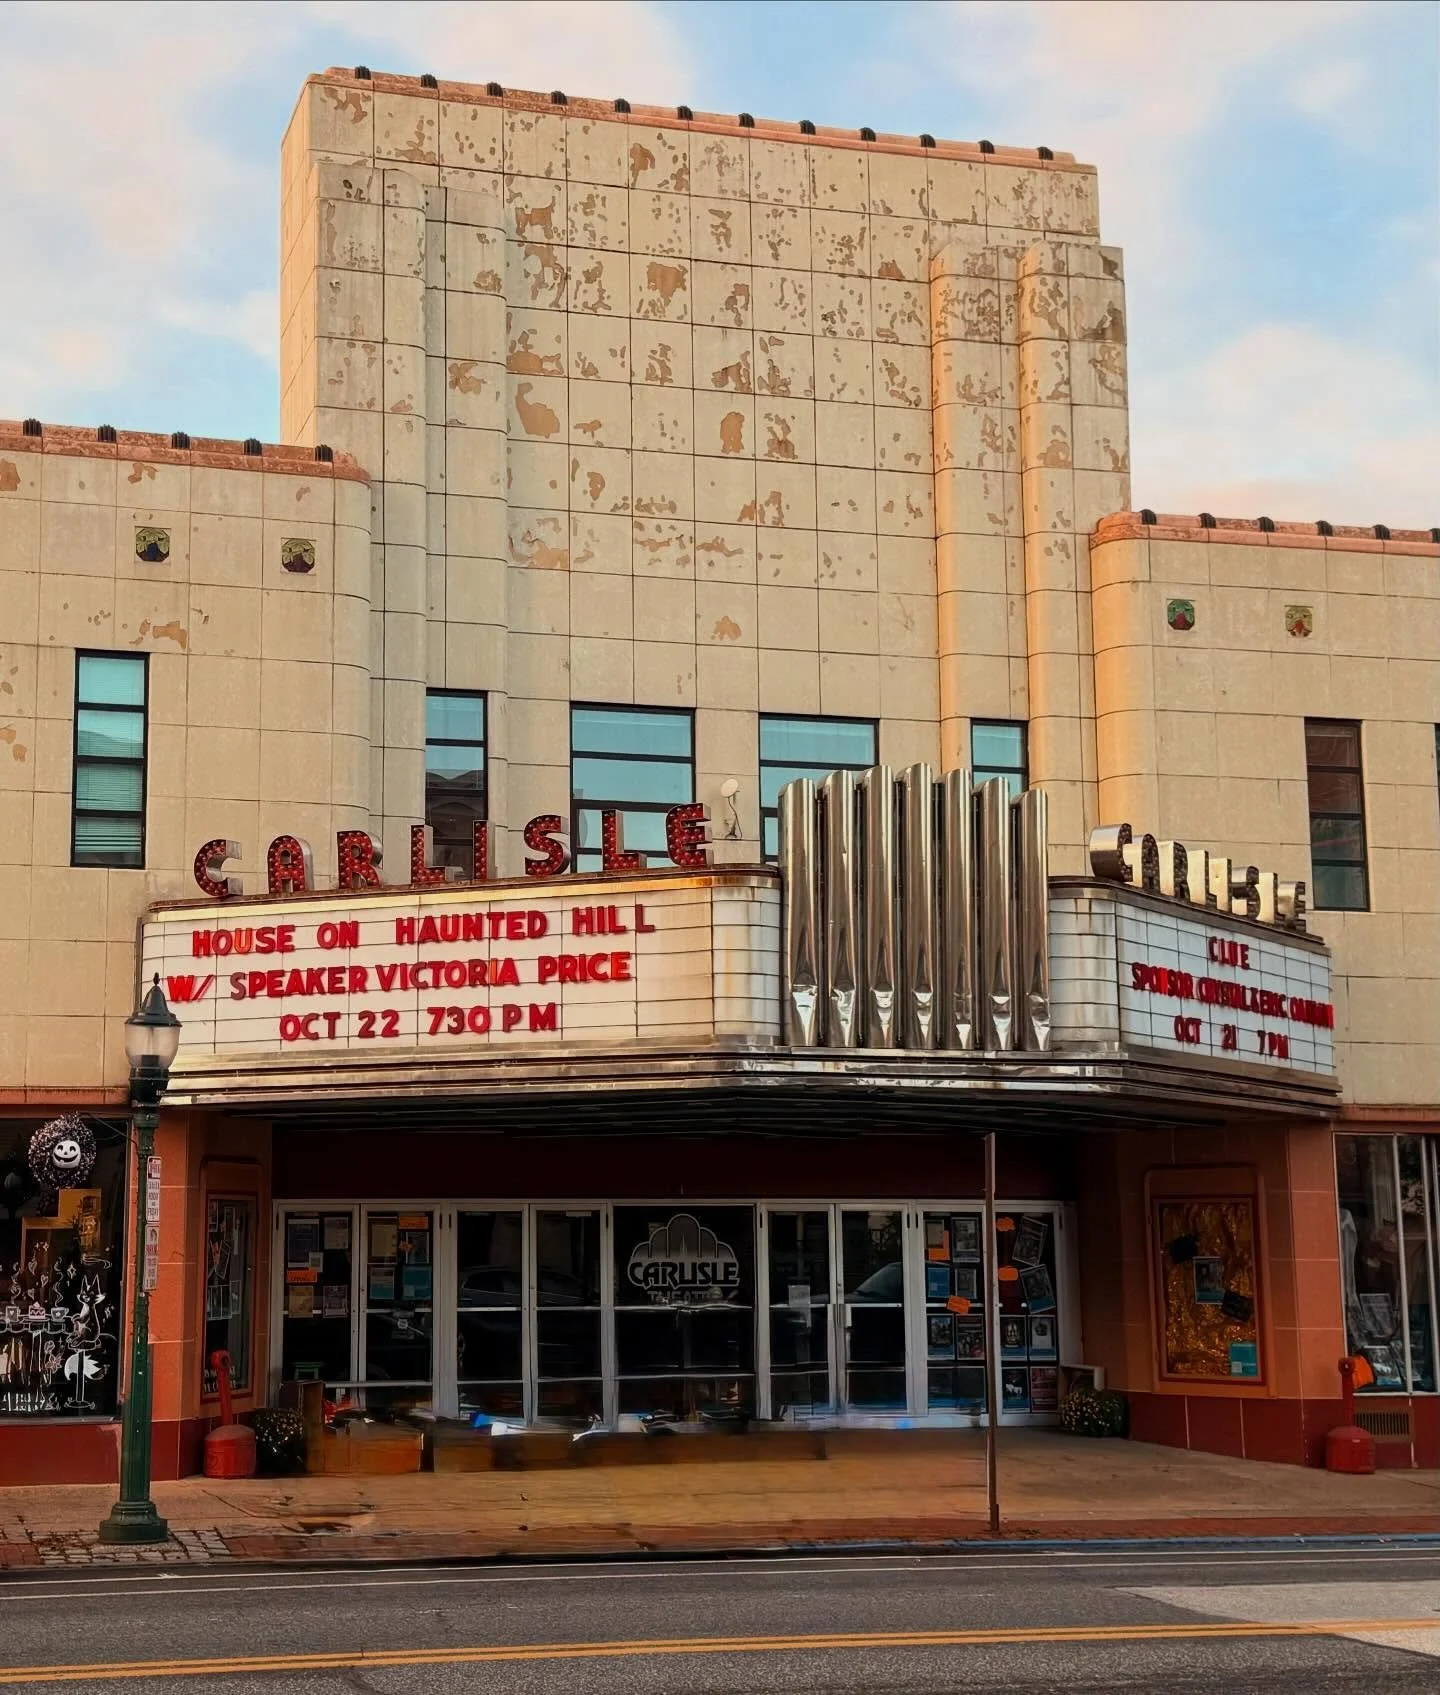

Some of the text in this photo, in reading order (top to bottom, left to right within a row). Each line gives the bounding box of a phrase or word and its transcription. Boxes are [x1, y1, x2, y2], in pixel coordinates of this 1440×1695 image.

[194, 802, 713, 898] CARLISLE
[192, 904, 656, 958] HOUSE ON HAUNTED HILL
[1208, 936, 1250, 970] CLUE
[166, 951, 633, 1003] W/ SPEAKER VICTORIA PRICE
[279, 1002, 558, 1041] OCT 22 730 PM
[1174, 1015, 1202, 1044] OCT
[1222, 1023, 1237, 1050] 21
[629, 1261, 740, 1289] CARLISLE
